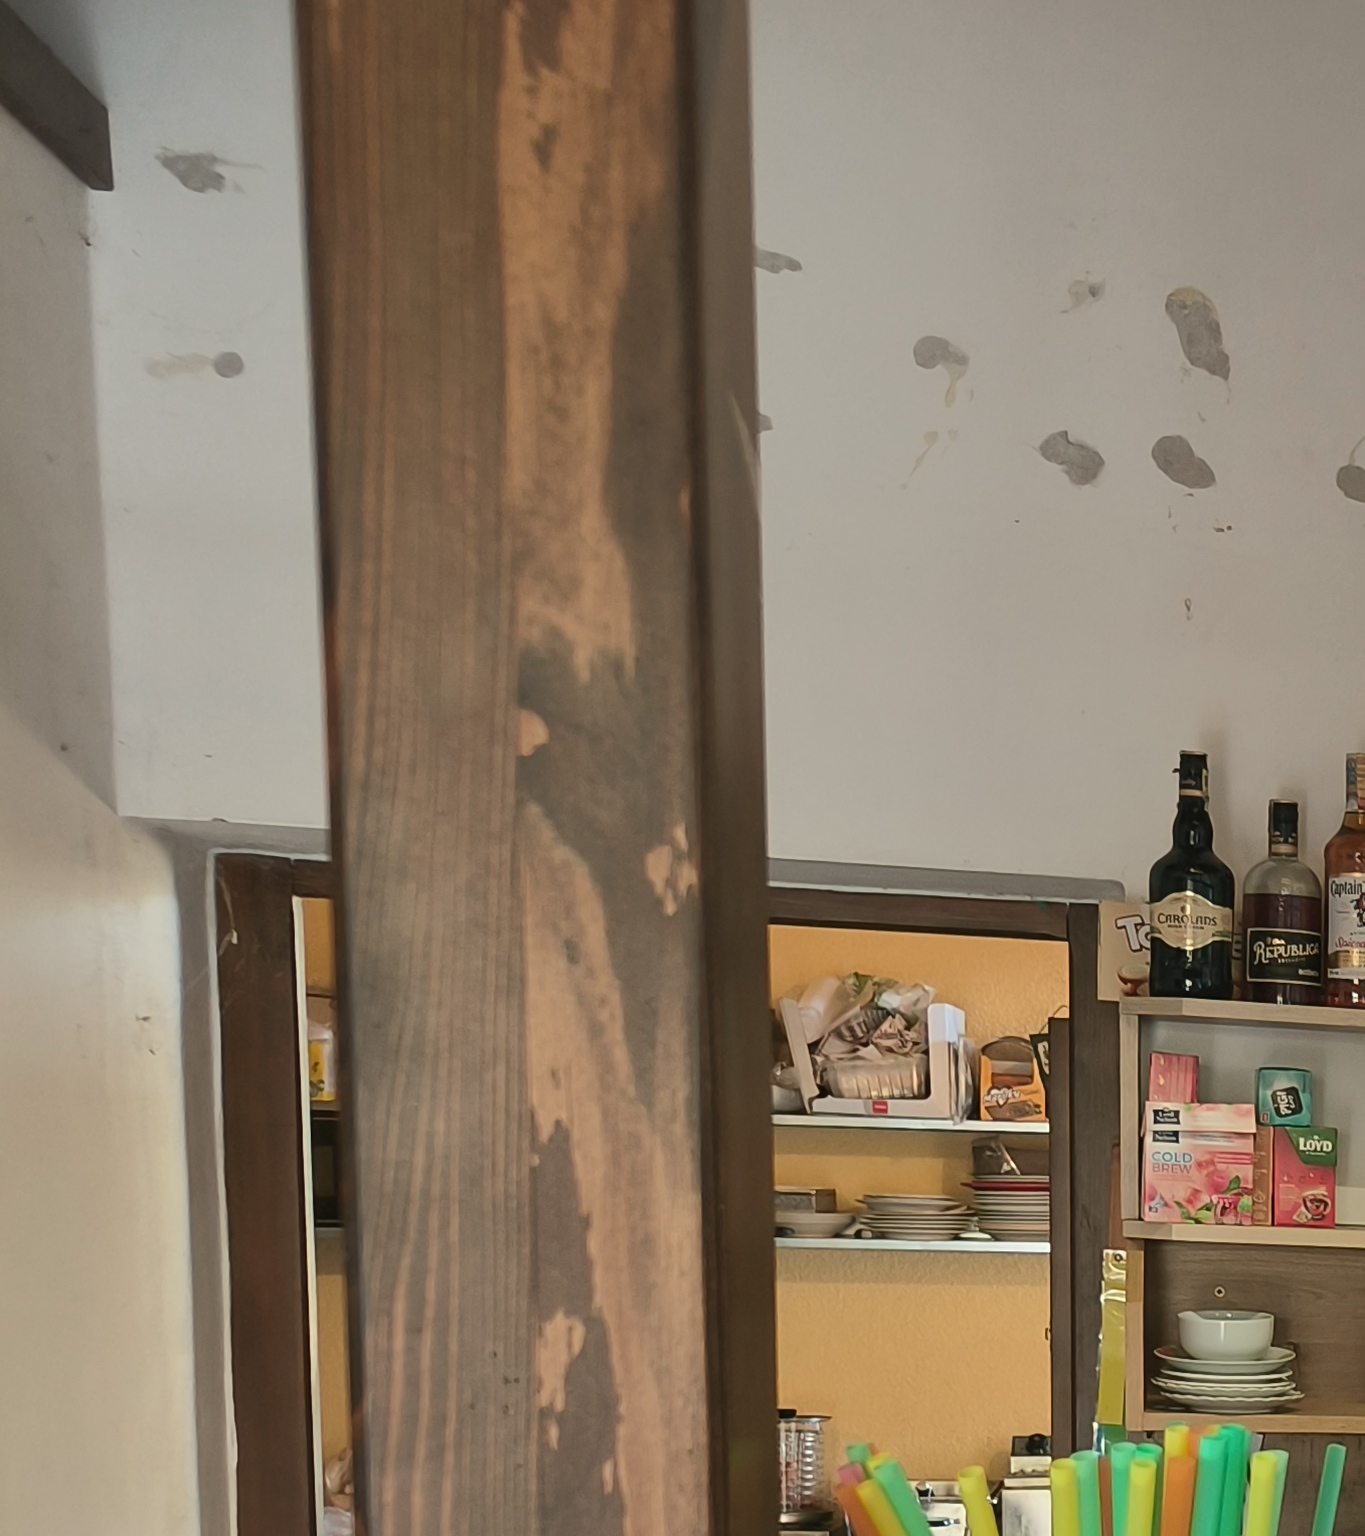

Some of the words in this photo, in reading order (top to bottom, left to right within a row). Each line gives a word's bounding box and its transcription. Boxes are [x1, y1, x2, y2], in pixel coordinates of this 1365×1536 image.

[1330, 880, 1363, 898] Captain
[1299, 1138, 1333, 1153] LOYD
[1151, 1151, 1193, 1164] COLD
[1152, 1163, 1193, 1175] BREW
